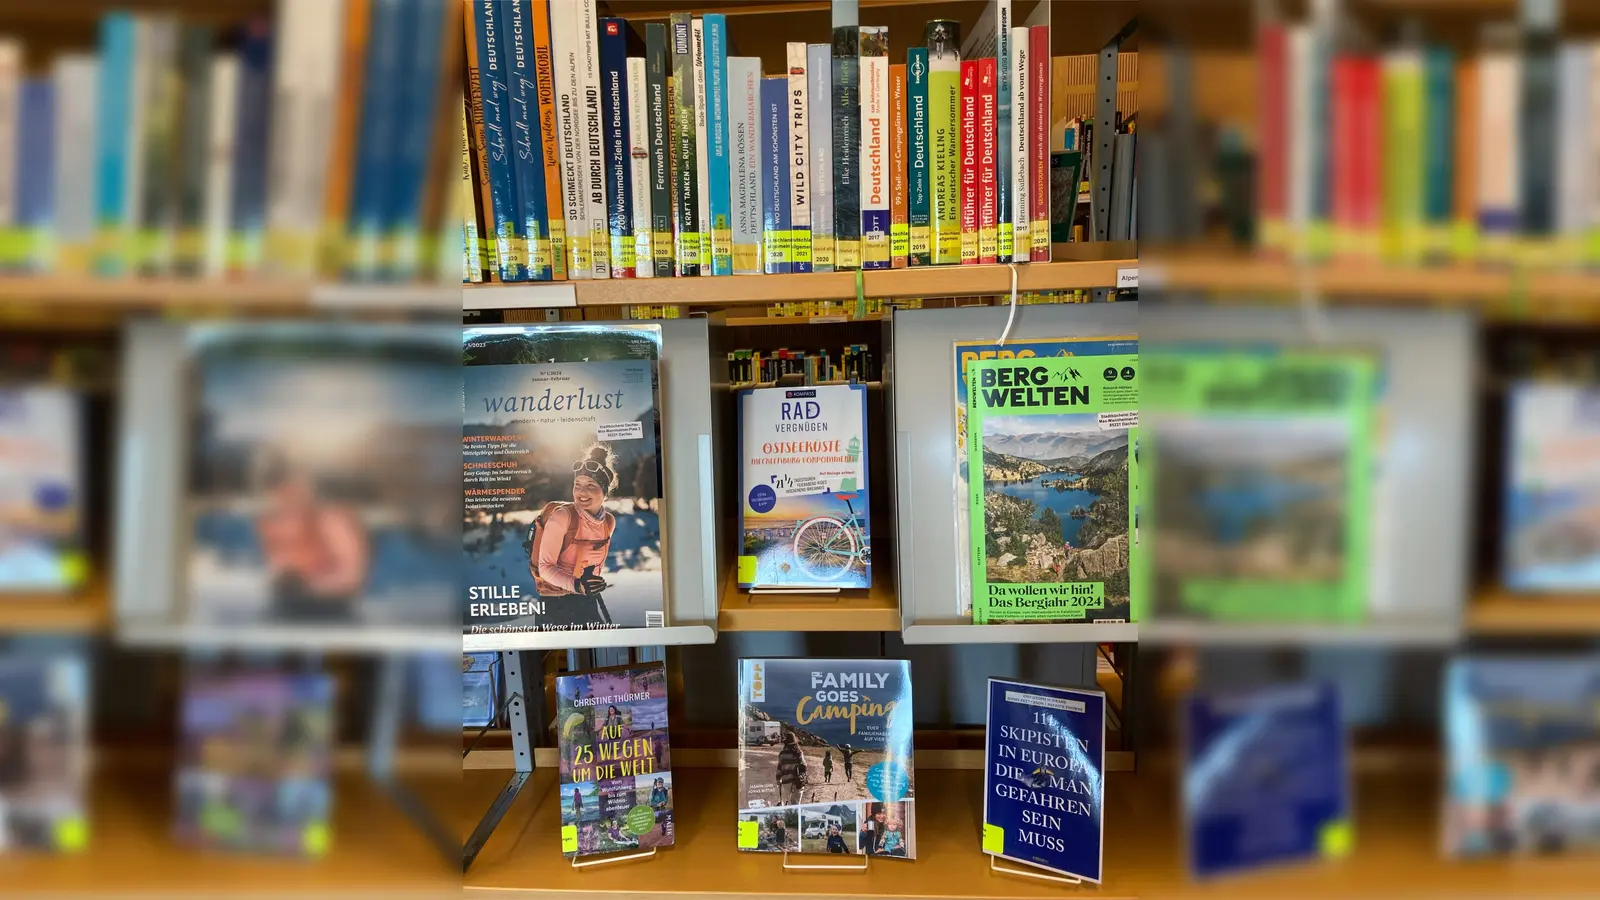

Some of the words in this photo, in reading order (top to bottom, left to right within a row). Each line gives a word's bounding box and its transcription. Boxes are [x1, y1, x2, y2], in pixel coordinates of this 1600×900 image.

[676, 24, 687, 54] DUMONT
[486, 73, 507, 98] weg!
[514, 71, 534, 96] weg!
[537, 45, 552, 106] WOHNMOBIL
[470, 66, 484, 124] KURVENZEIT
[571, 87, 577, 96] ZU
[610, 71, 621, 128] Deutschland
[841, 86, 849, 107] Alles
[1018, 92, 1024, 101] ab
[486, 99, 500, 121] mal
[514, 97, 528, 120] mal
[585, 86, 600, 156] DEUTSCHLAND!
[652, 84, 663, 146] Deutschland
[794, 90, 803, 128] TRIPS
[561, 94, 573, 159] DEUTSCHLAND
[572, 108, 580, 137] NORDSEE
[613, 129, 621, 139] in
[914, 96, 924, 168] Deutschland
[964, 96, 974, 165] Deutschland
[982, 94, 992, 164] Deutschland
[489, 122, 507, 165] Schnell
[516, 121, 534, 163] Schnell
[795, 134, 804, 165] CITY
[841, 116, 849, 164] Heidenreich
[937, 128, 945, 171] KIELING
[655, 149, 664, 190] Fernweh
[773, 154, 778, 164] AM
[869, 118, 881, 204] Deutschland
[566, 161, 576, 207] SCHMECKT
[590, 160, 602, 189] DURCH
[614, 140, 625, 213] Wohnmobil-Ziele
[842, 166, 850, 185] Elke
[964, 168, 974, 185] für
[982, 167, 992, 183] für
[592, 192, 602, 204] AB
[796, 172, 804, 206] WILD
[937, 175, 945, 220] ANDREAS
[569, 209, 577, 220] SO
[774, 212, 780, 224] WO
[981, 366, 1048, 387] BERG
[484, 387, 624, 413] wanderlust
[981, 386, 1089, 408] WELTEN
[781, 401, 820, 420] RAD
[775, 422, 828, 432] VERGNÜGEN
[762, 440, 840, 454] OSTSEEKÜSTE
[469, 585, 520, 600] STILLE
[989, 585, 1006, 596] Da
[1008, 584, 1047, 596] wollen
[1049, 584, 1068, 595] wir
[1071, 584, 1094, 594] hin!
[989, 597, 1013, 608] Das
[1015, 596, 1069, 610] Bergjahr
[1071, 596, 1102, 606] 2024
[470, 601, 546, 617] ERLEBEN!
[471, 625, 487, 634] Die
[489, 624, 540, 634] schönsten
[542, 623, 568, 632] Wege
[570, 622, 583, 631] im
[586, 621, 620, 630] Winter
[753, 664, 762, 699] TOPP
[811, 672, 890, 689] FAMILY
[574, 696, 612, 708] CHRISTINE
[613, 691, 650, 703] THÜRMER
[816, 691, 859, 702] GOES
[796, 696, 897, 736] Camping
[601, 725, 624, 740] AUF
[574, 744, 594, 766] 25
[599, 737, 653, 761] WEGEN
[998, 744, 1016, 760] IN
[1020, 749, 1088, 774] EUROPA
[572, 768, 591, 783] UM
[596, 764, 616, 780] DIE
[620, 756, 656, 777] WELT
[995, 763, 1024, 781] DIE
[1049, 775, 1092, 796] MAN
[996, 783, 1092, 817] GEFAHREN
[1022, 810, 1062, 831] SEIN
[1018, 829, 1065, 853] MUSS
